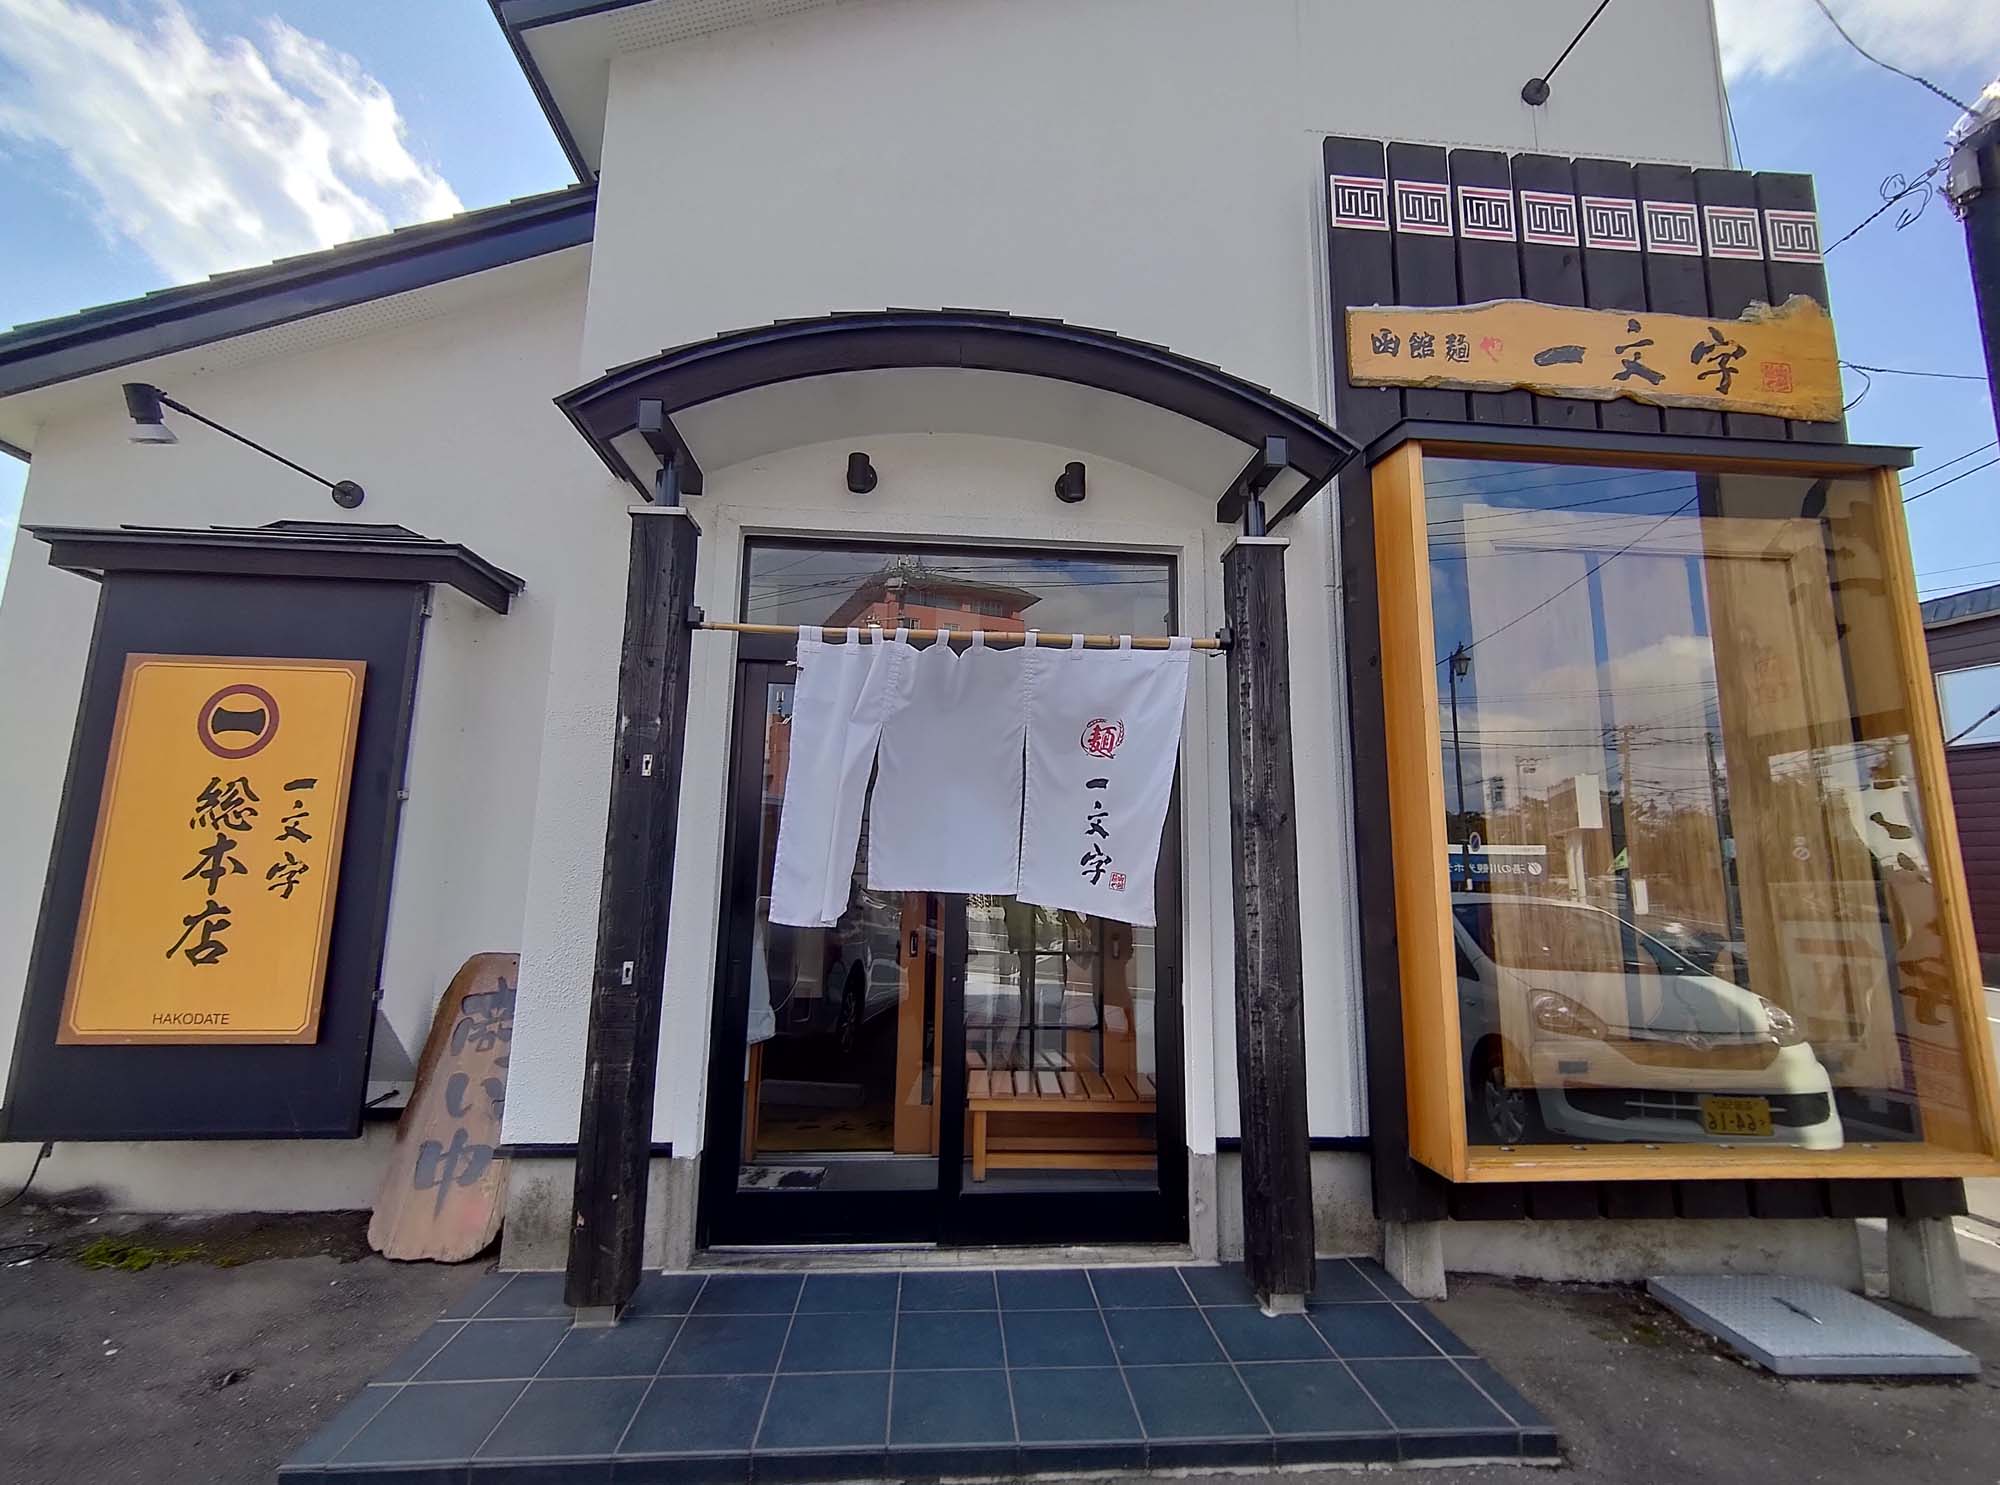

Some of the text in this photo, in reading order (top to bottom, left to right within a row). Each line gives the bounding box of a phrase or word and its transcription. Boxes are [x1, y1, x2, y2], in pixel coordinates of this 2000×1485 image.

[1534, 319, 1747, 395] 一文字
[165, 776, 260, 966] 総本店
[264, 777, 318, 899] 一文字
[1080, 778, 1112, 885] 一文字
[152, 1013, 231, 1026] HAKODATE
